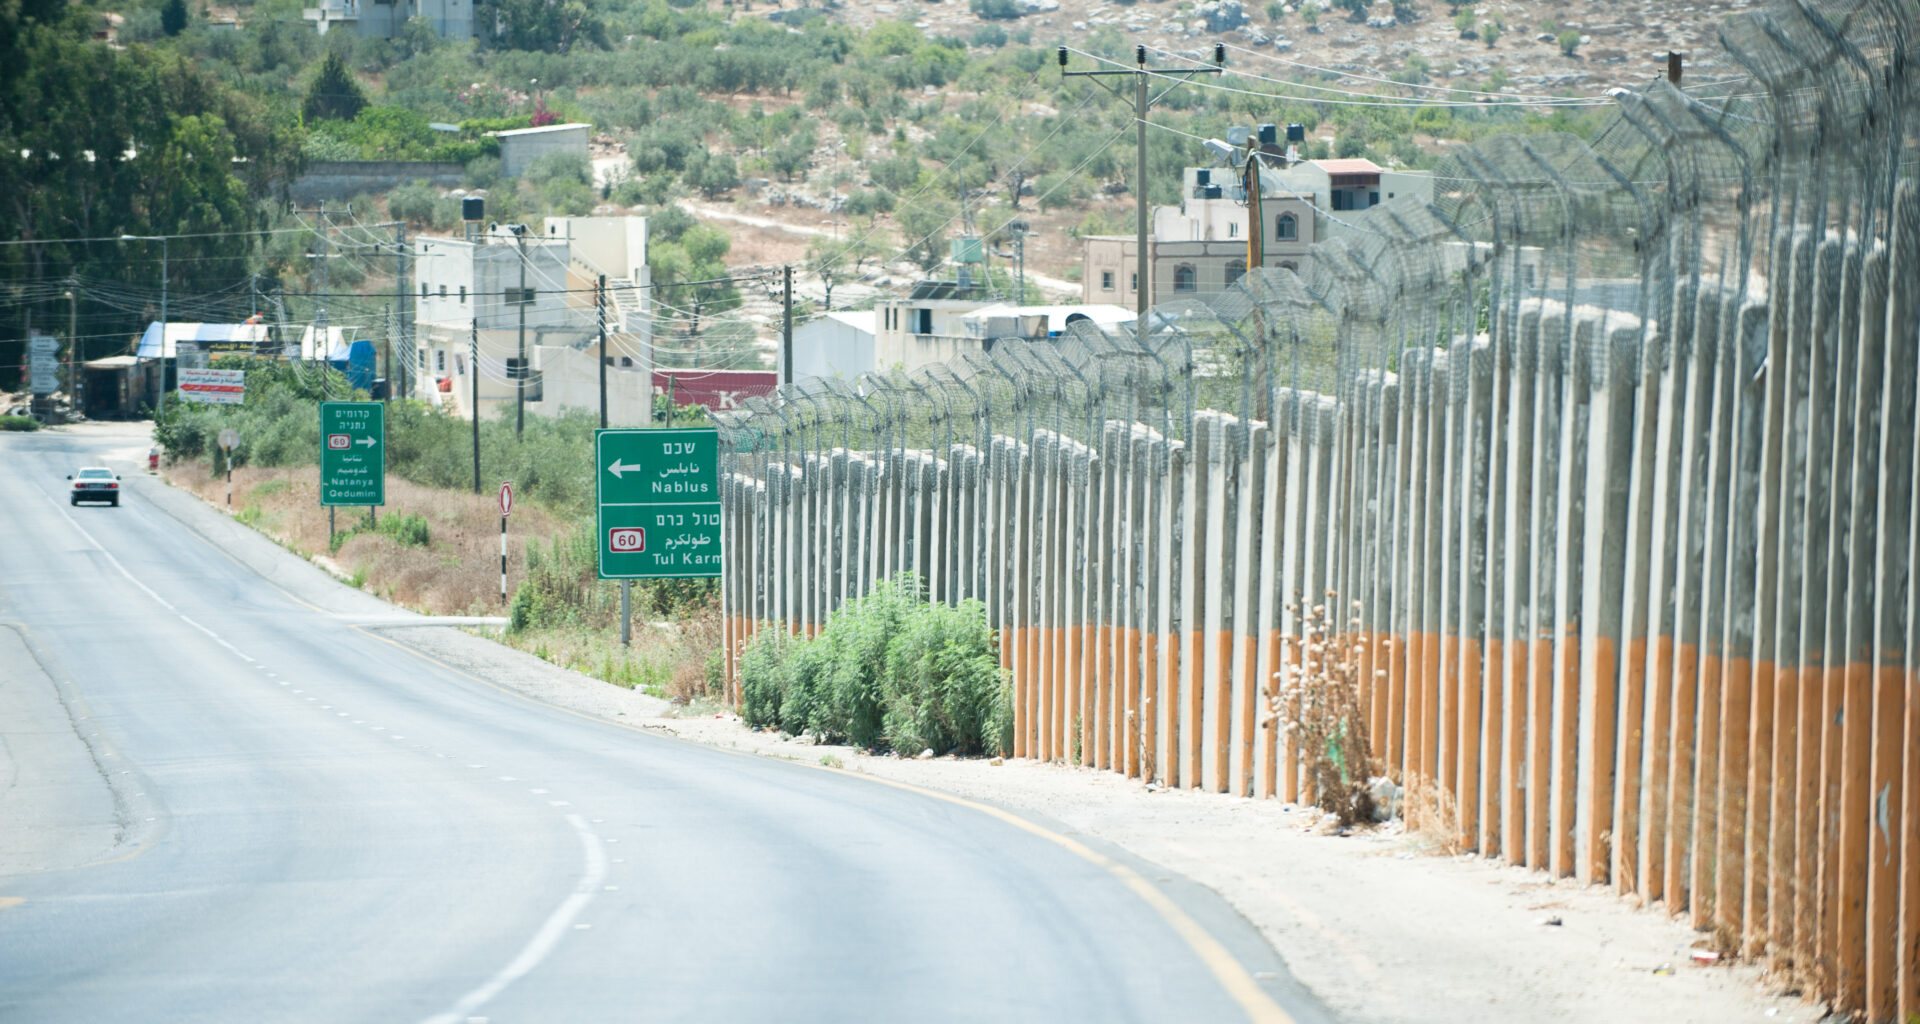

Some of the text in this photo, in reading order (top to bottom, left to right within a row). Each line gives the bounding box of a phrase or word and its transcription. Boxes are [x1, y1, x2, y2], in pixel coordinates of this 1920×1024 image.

[335, 410, 370, 419] קדומים
[339, 421, 366, 430] נתניה
[334, 438, 346, 446] 60
[662, 443, 696, 455] שכם
[659, 463, 700, 478] نابلس
[331, 478, 374, 487] Natanya
[652, 481, 709, 493] Nablus
[329, 489, 376, 498] Qedumim
[656, 512, 720, 526] טול כרם
[618, 535, 636, 546] 60
[665, 533, 711, 550] طولكرم
[652, 553, 721, 565] Tul Karm
